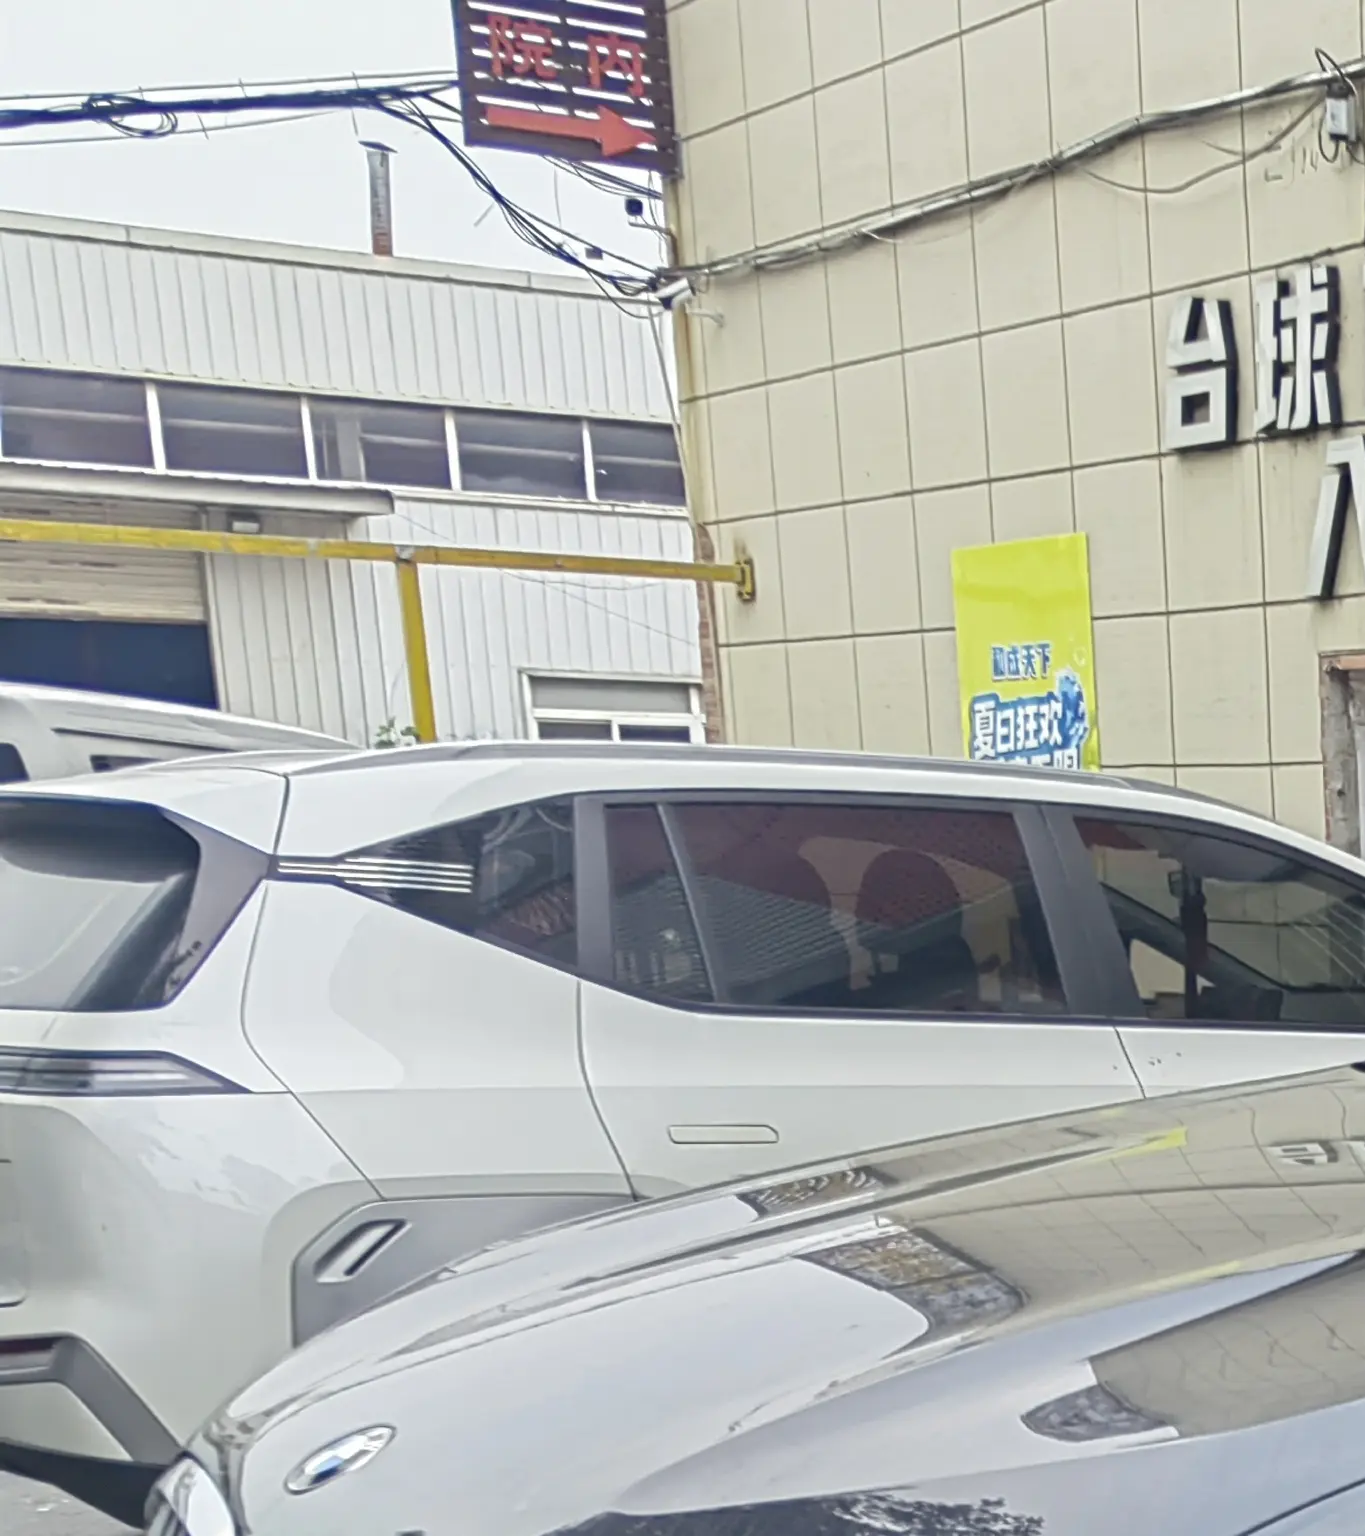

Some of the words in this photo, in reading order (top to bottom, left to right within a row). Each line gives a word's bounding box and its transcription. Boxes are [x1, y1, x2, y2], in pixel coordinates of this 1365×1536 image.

[486, 13, 644, 97] 院内
[973, 699, 1063, 760] 夏日狂欢
